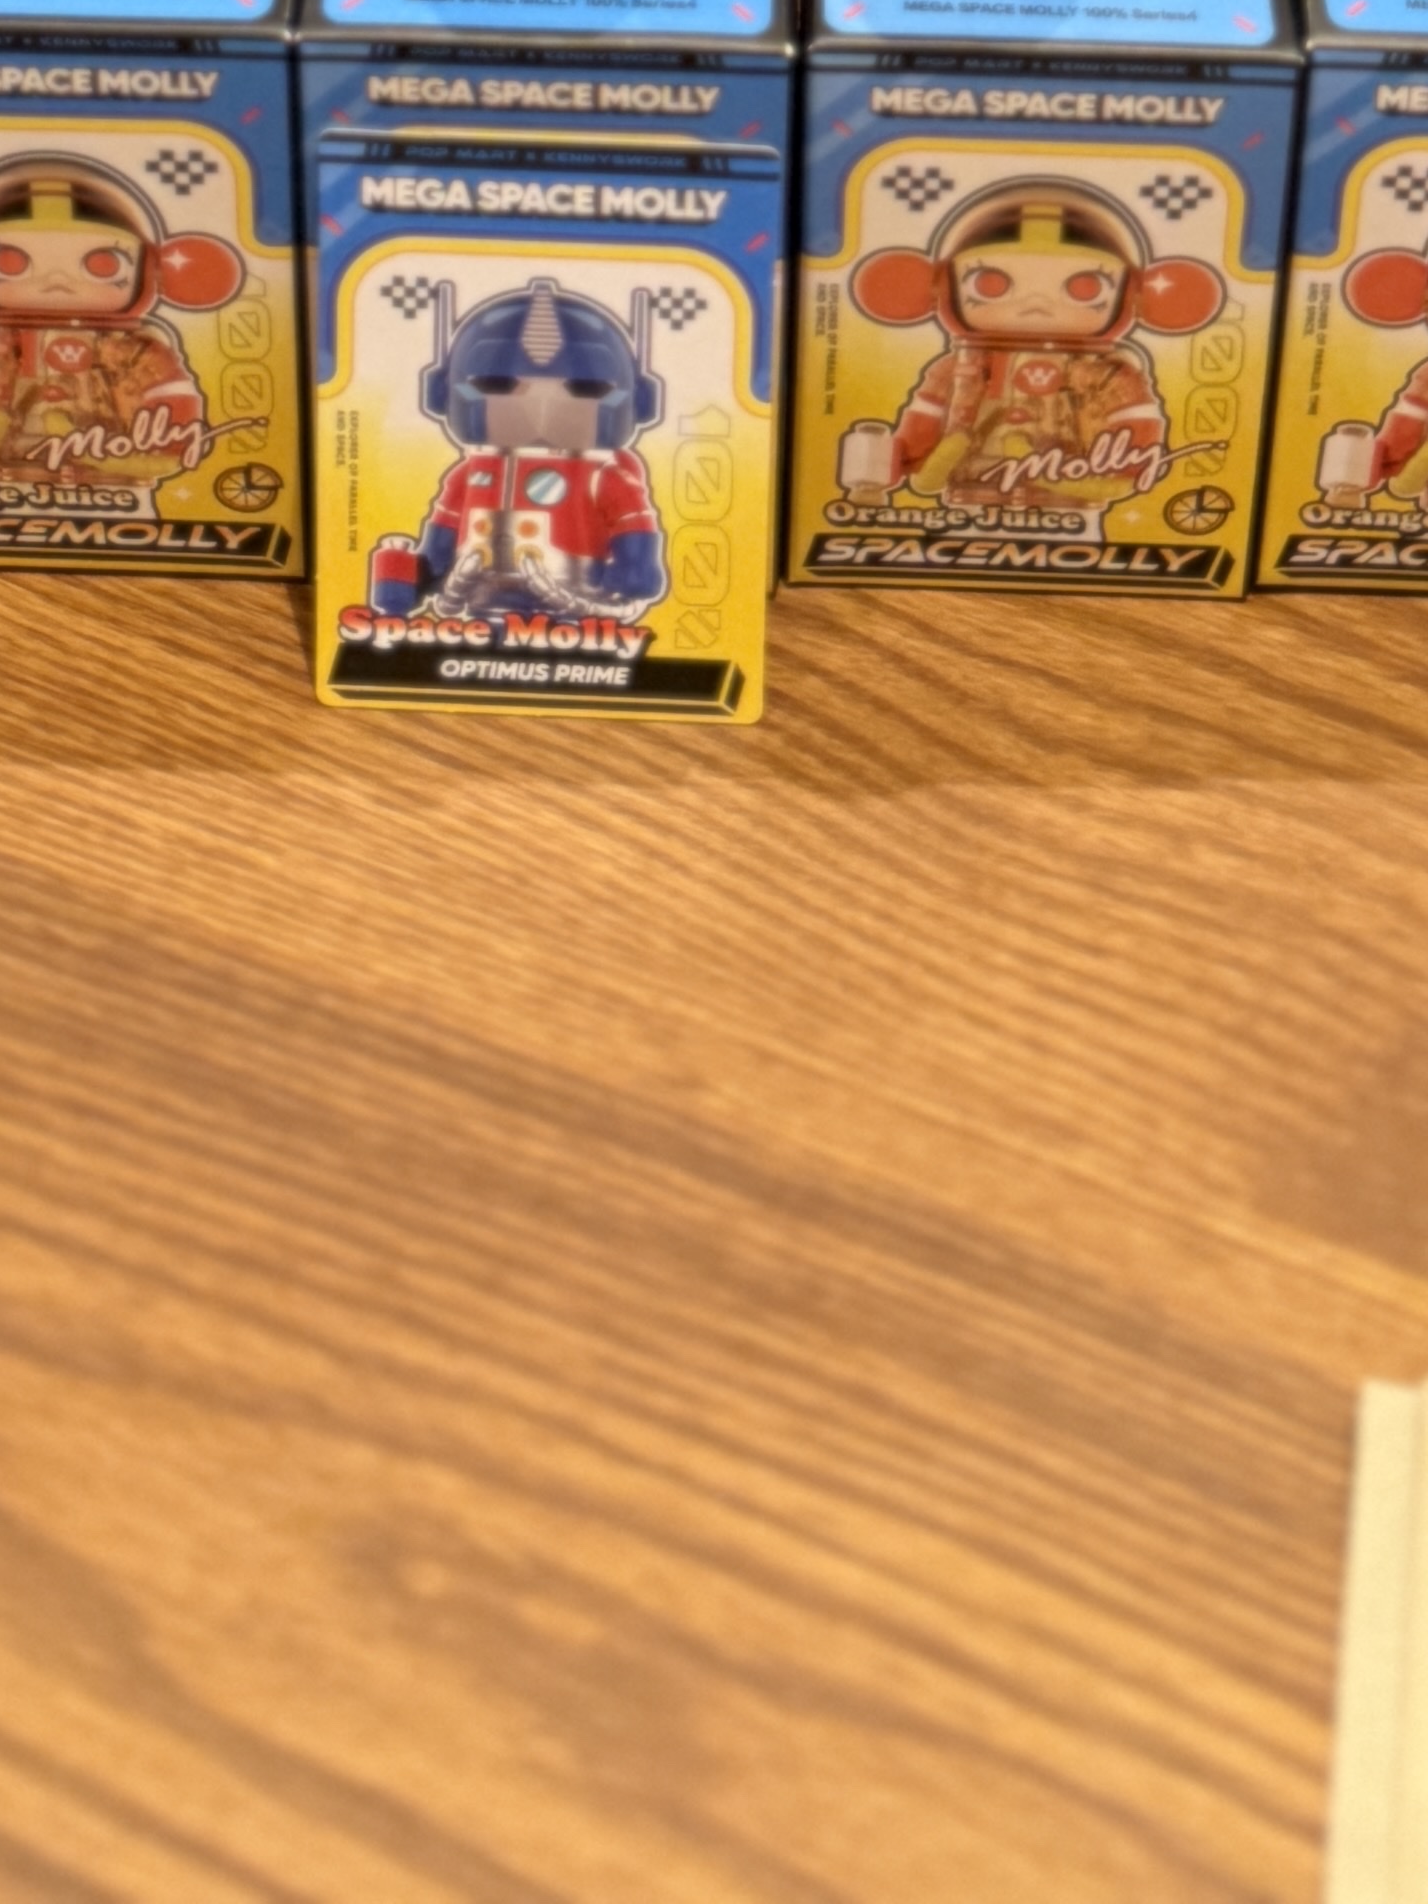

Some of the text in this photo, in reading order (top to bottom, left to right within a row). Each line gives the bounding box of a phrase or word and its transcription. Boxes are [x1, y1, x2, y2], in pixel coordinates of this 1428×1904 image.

[904, 0, 954, 12] MEGA
[959, 1, 1017, 14] SPACE
[1020, 3, 1080, 17] MOLLY
[98, 69, 219, 97] MOLLY
[367, 76, 720, 112] MEGA SPACE MOLLY
[871, 88, 1224, 124] MEGA SPACE MOLLY
[463, 148, 517, 163] MART
[361, 177, 727, 220] MEGA SPACE MOLLY
[27, 407, 268, 471] Molly
[981, 431, 1228, 491] Molly
[27, 485, 137, 508] Juice
[824, 502, 1086, 531] Orange Juice
[338, 608, 651, 658] Space Molly
[440, 659, 629, 685] OPTIMUS PRIME
